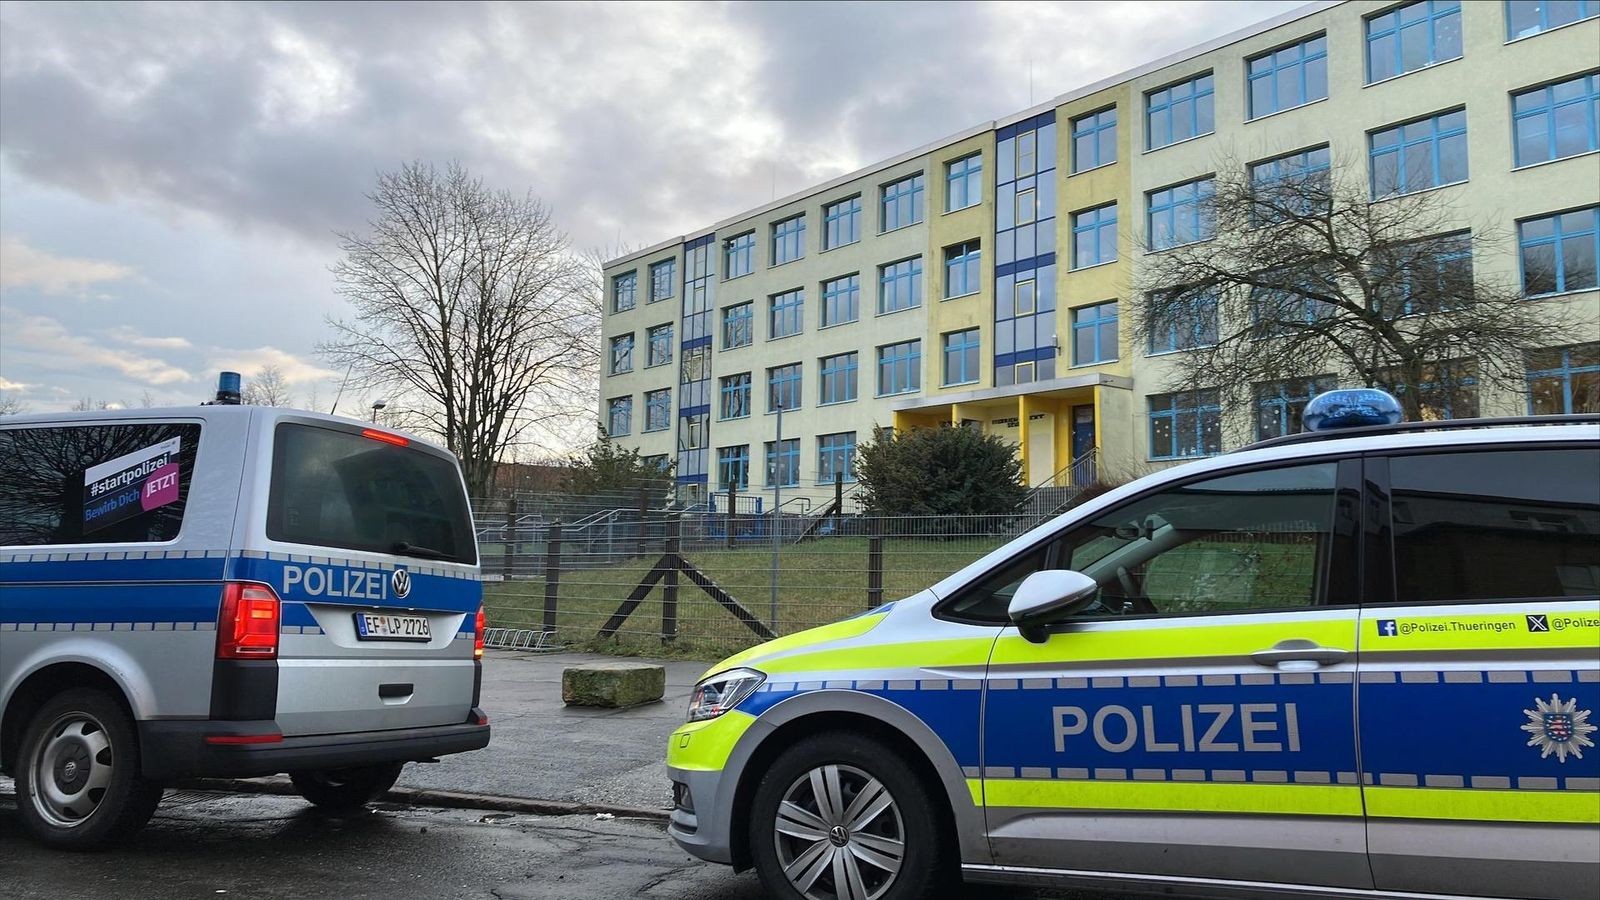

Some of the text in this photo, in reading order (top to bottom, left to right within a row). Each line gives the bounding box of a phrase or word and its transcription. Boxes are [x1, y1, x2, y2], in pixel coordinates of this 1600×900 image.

[90, 453, 168, 497] #startpolizei
[146, 472, 177, 497] JETZT
[85, 489, 140, 521] Bewirb Dich
[283, 565, 387, 600] POLIZEI
[365, 616, 429, 635] EF LP 2726
[1399, 620, 1516, 635] @Polizei.Thueringen
[1052, 702, 1301, 753] POLIZEI
